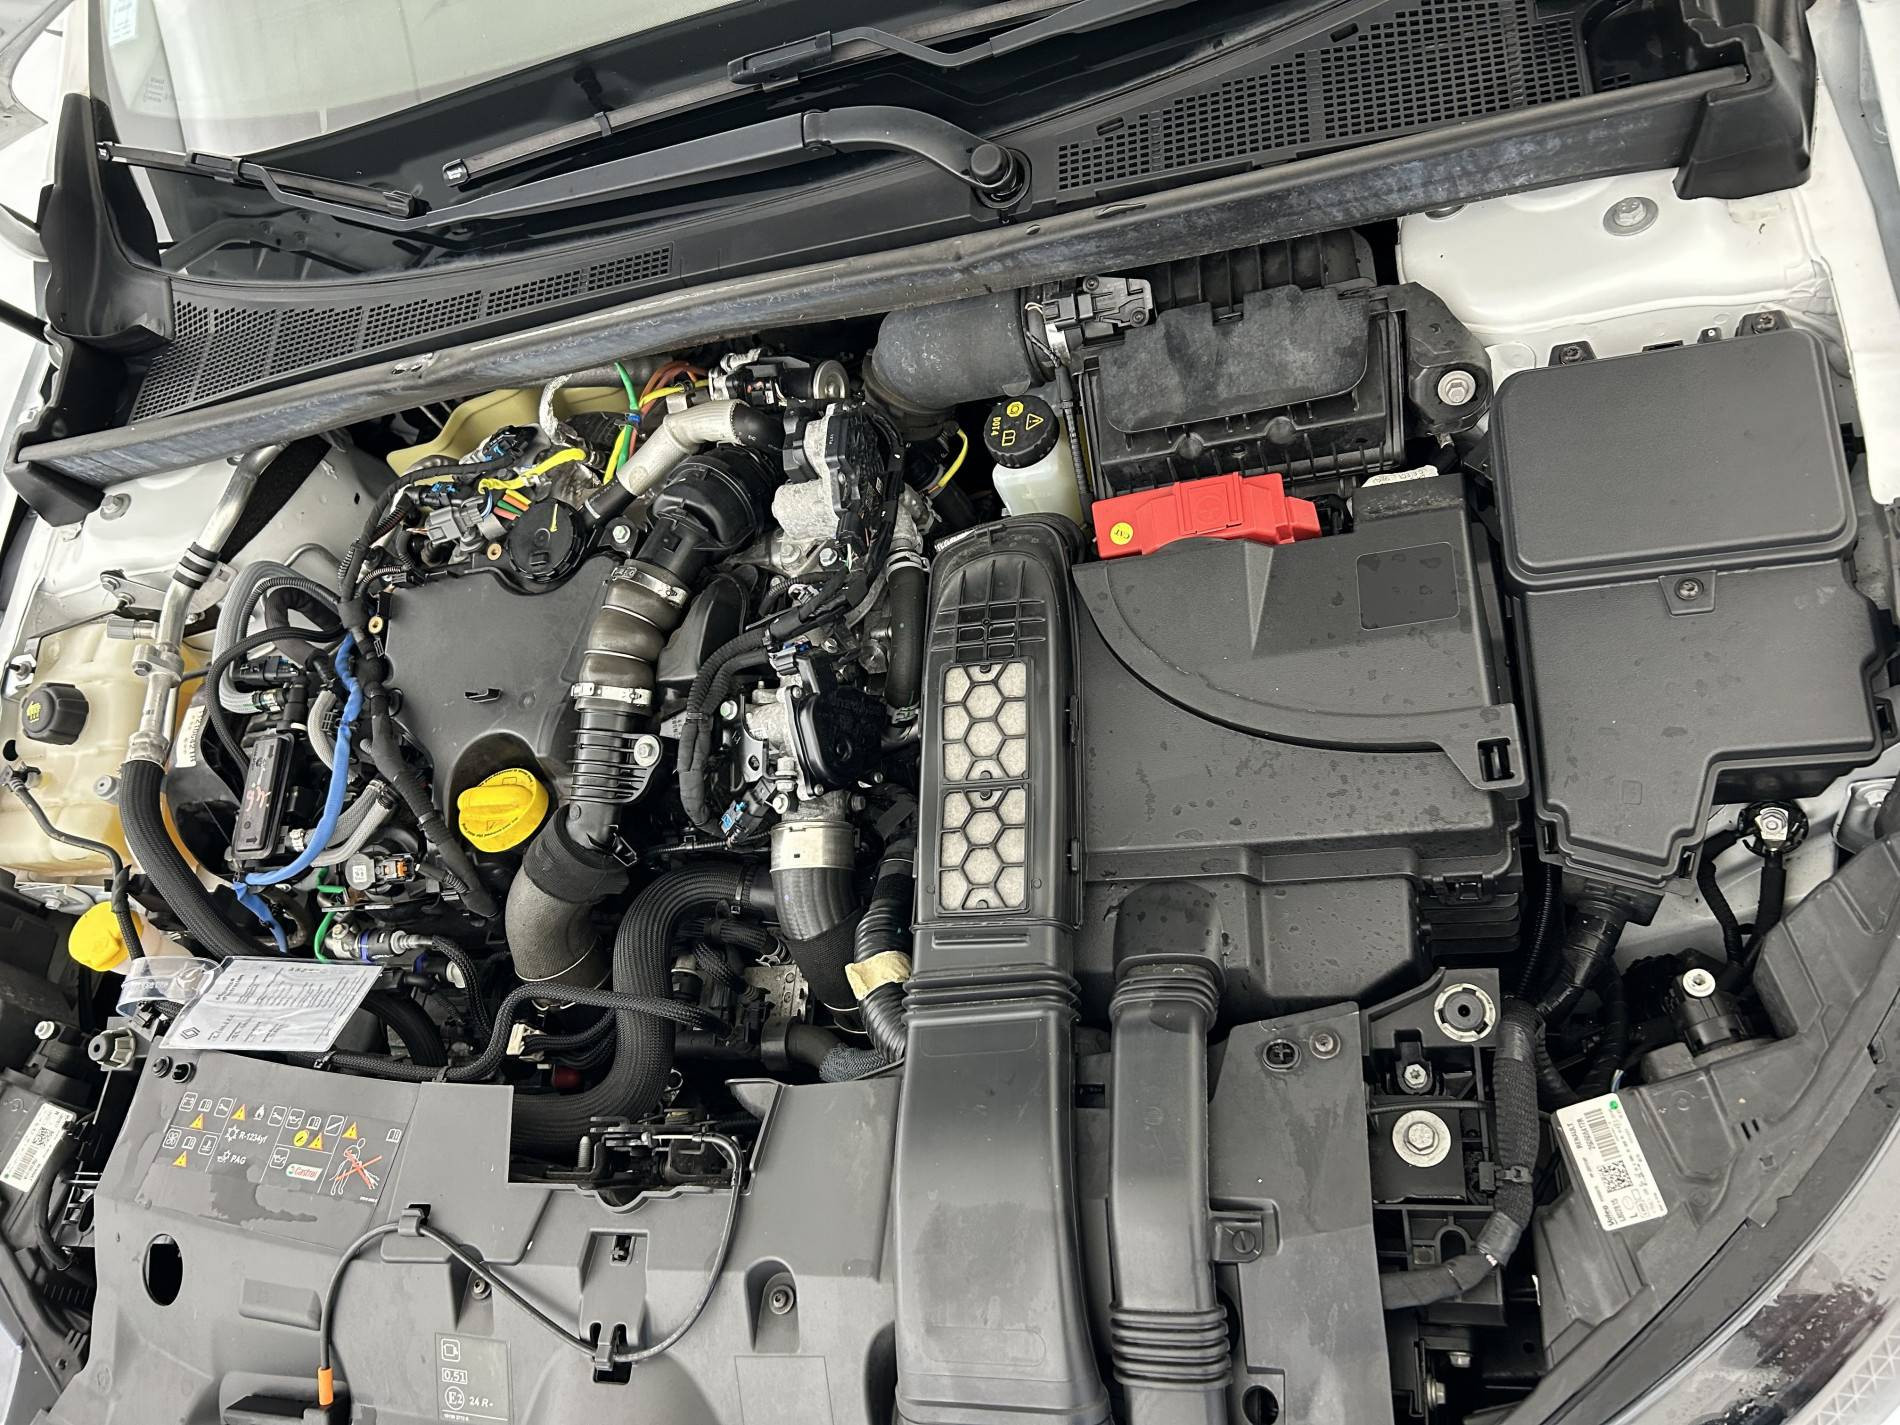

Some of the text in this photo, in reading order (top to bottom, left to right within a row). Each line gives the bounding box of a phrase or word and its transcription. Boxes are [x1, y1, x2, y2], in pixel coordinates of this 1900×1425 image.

[238, 1131, 268, 1144] R-1234yf
[230, 1153, 247, 1165] PAG
[294, 1166, 317, 1178] Castrol
[444, 1370, 465, 1382] 0,51
[448, 1391, 463, 1405] E2
[469, 1396, 479, 1406] 24
